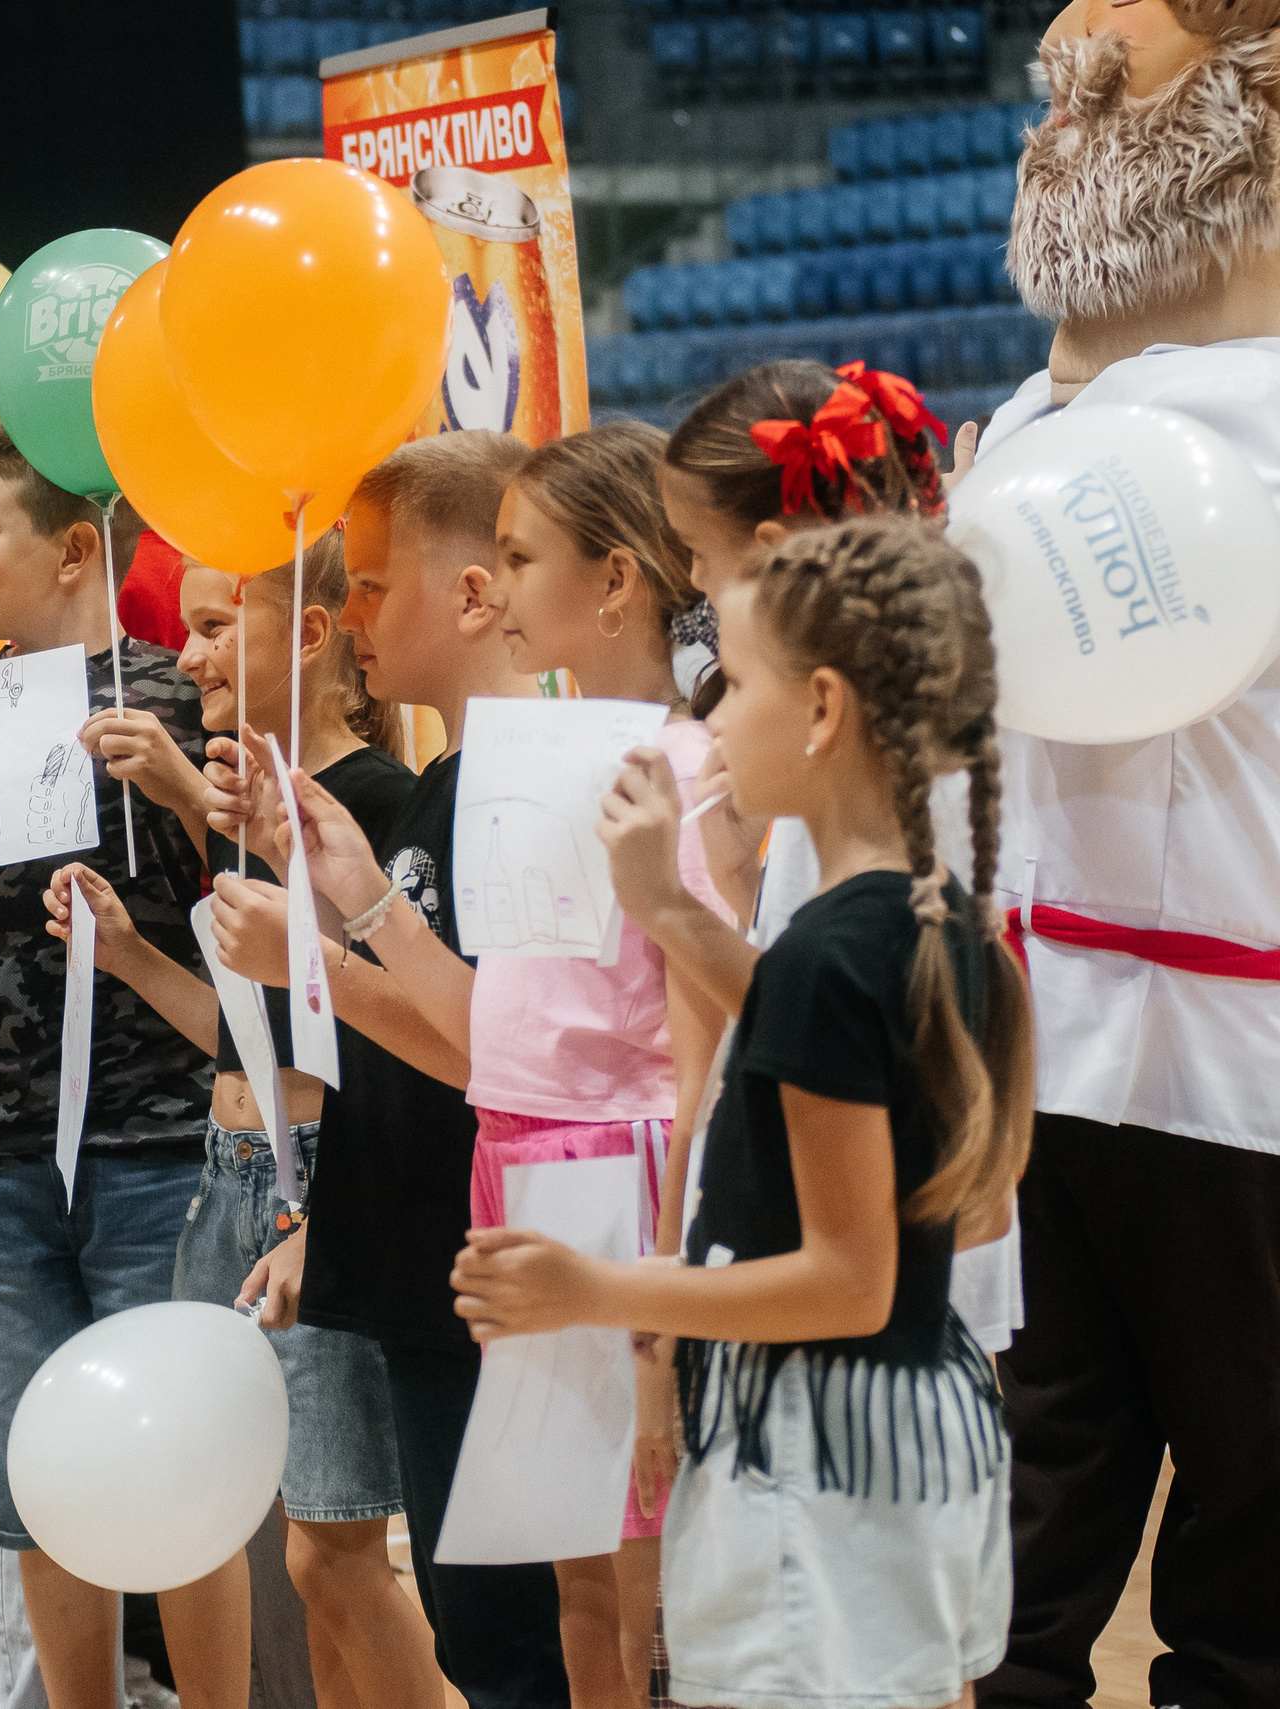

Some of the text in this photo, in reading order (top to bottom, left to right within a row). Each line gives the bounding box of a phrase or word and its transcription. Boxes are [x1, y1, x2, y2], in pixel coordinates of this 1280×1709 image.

[341, 102, 534, 179] БРЯНСКПИВО
[1016, 500, 1096, 656] БРЯНСКПИВО
[1056, 471, 1161, 641] КЛЮЧ
